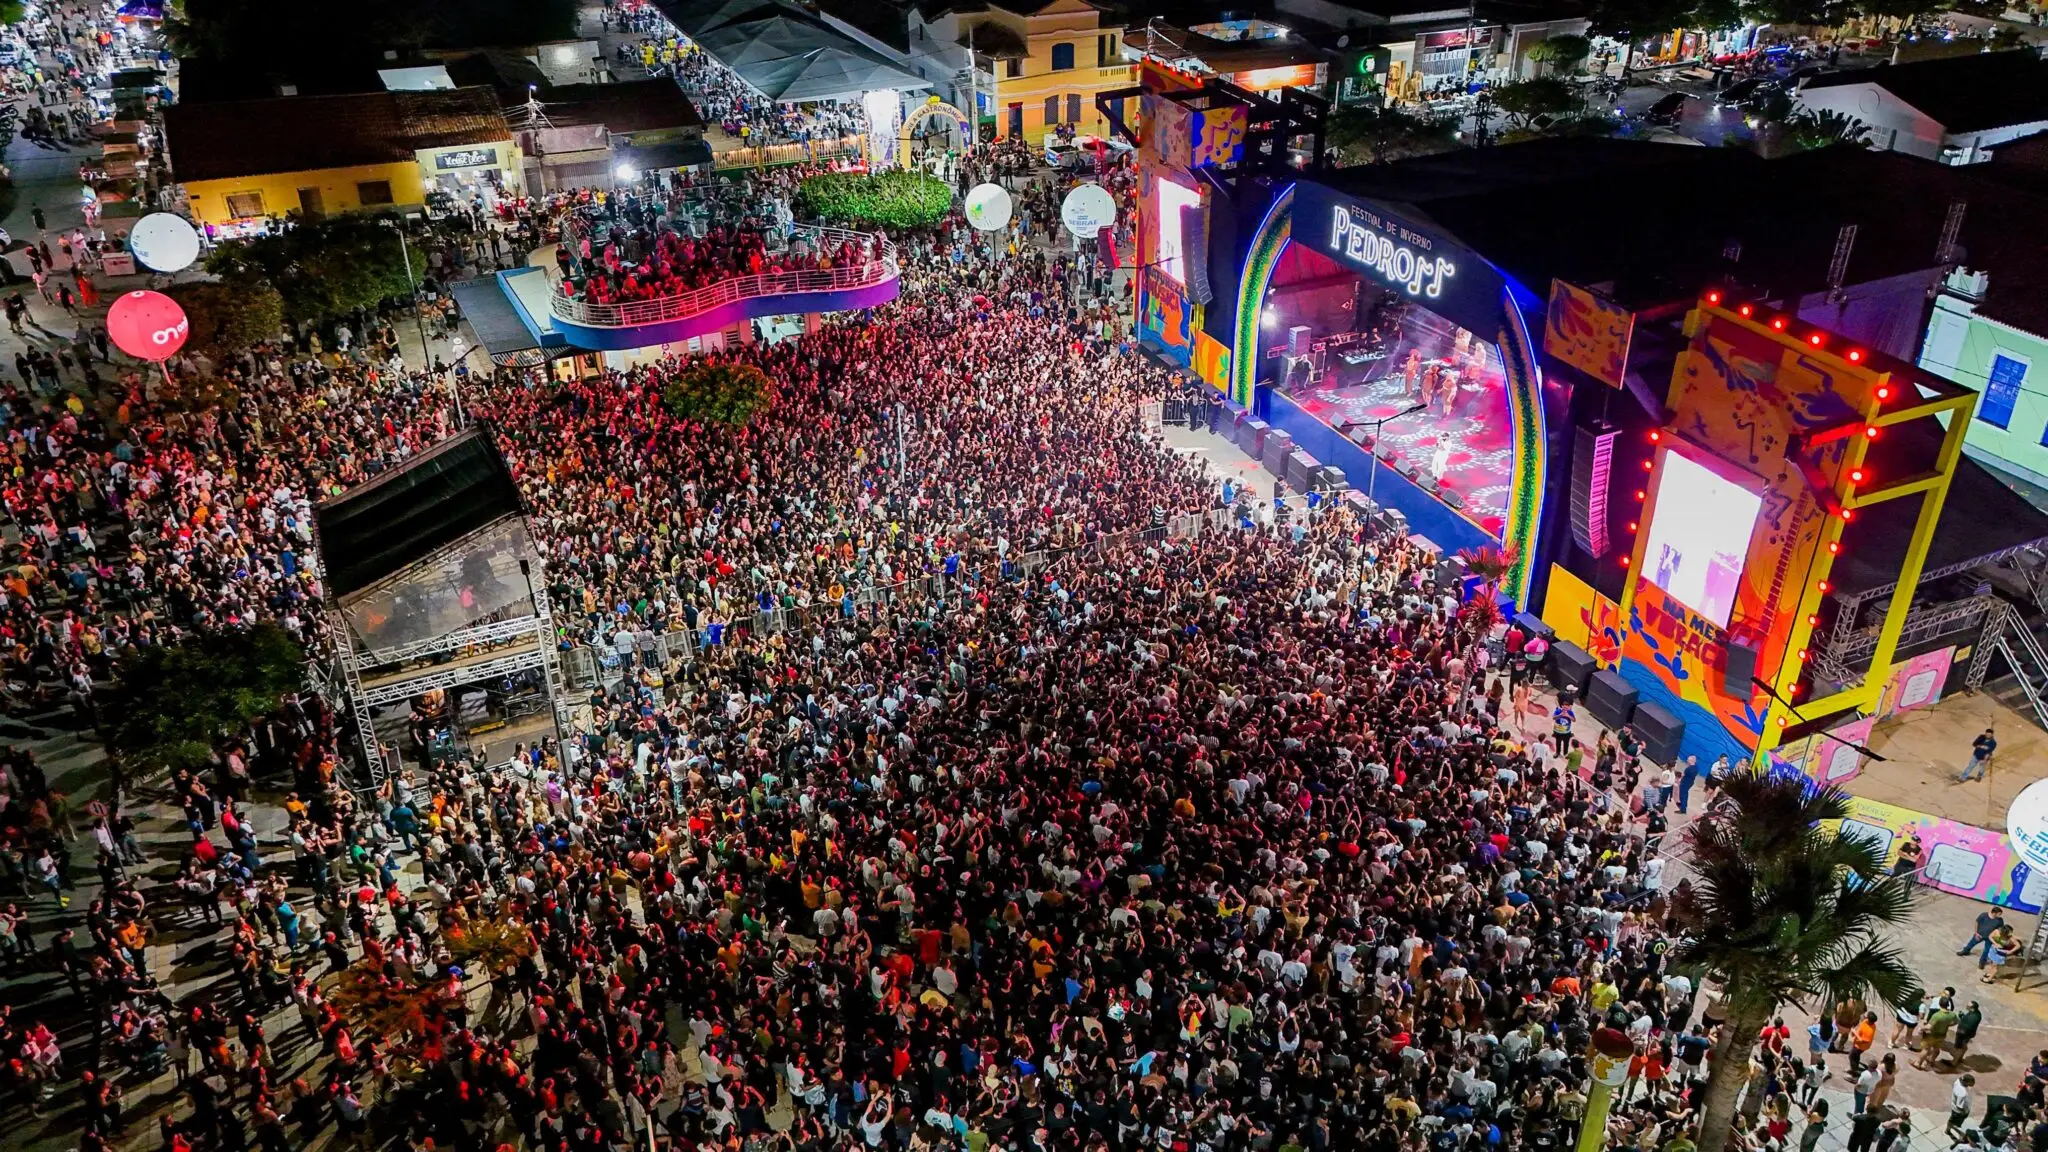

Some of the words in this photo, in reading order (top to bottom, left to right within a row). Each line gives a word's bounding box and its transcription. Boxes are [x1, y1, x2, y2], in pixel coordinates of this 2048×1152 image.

[1351, 205, 1382, 229] FESTIVAL
[1386, 221, 1397, 235] DE
[1400, 228, 1432, 250] INVERNO
[1662, 596, 1686, 624] NA
